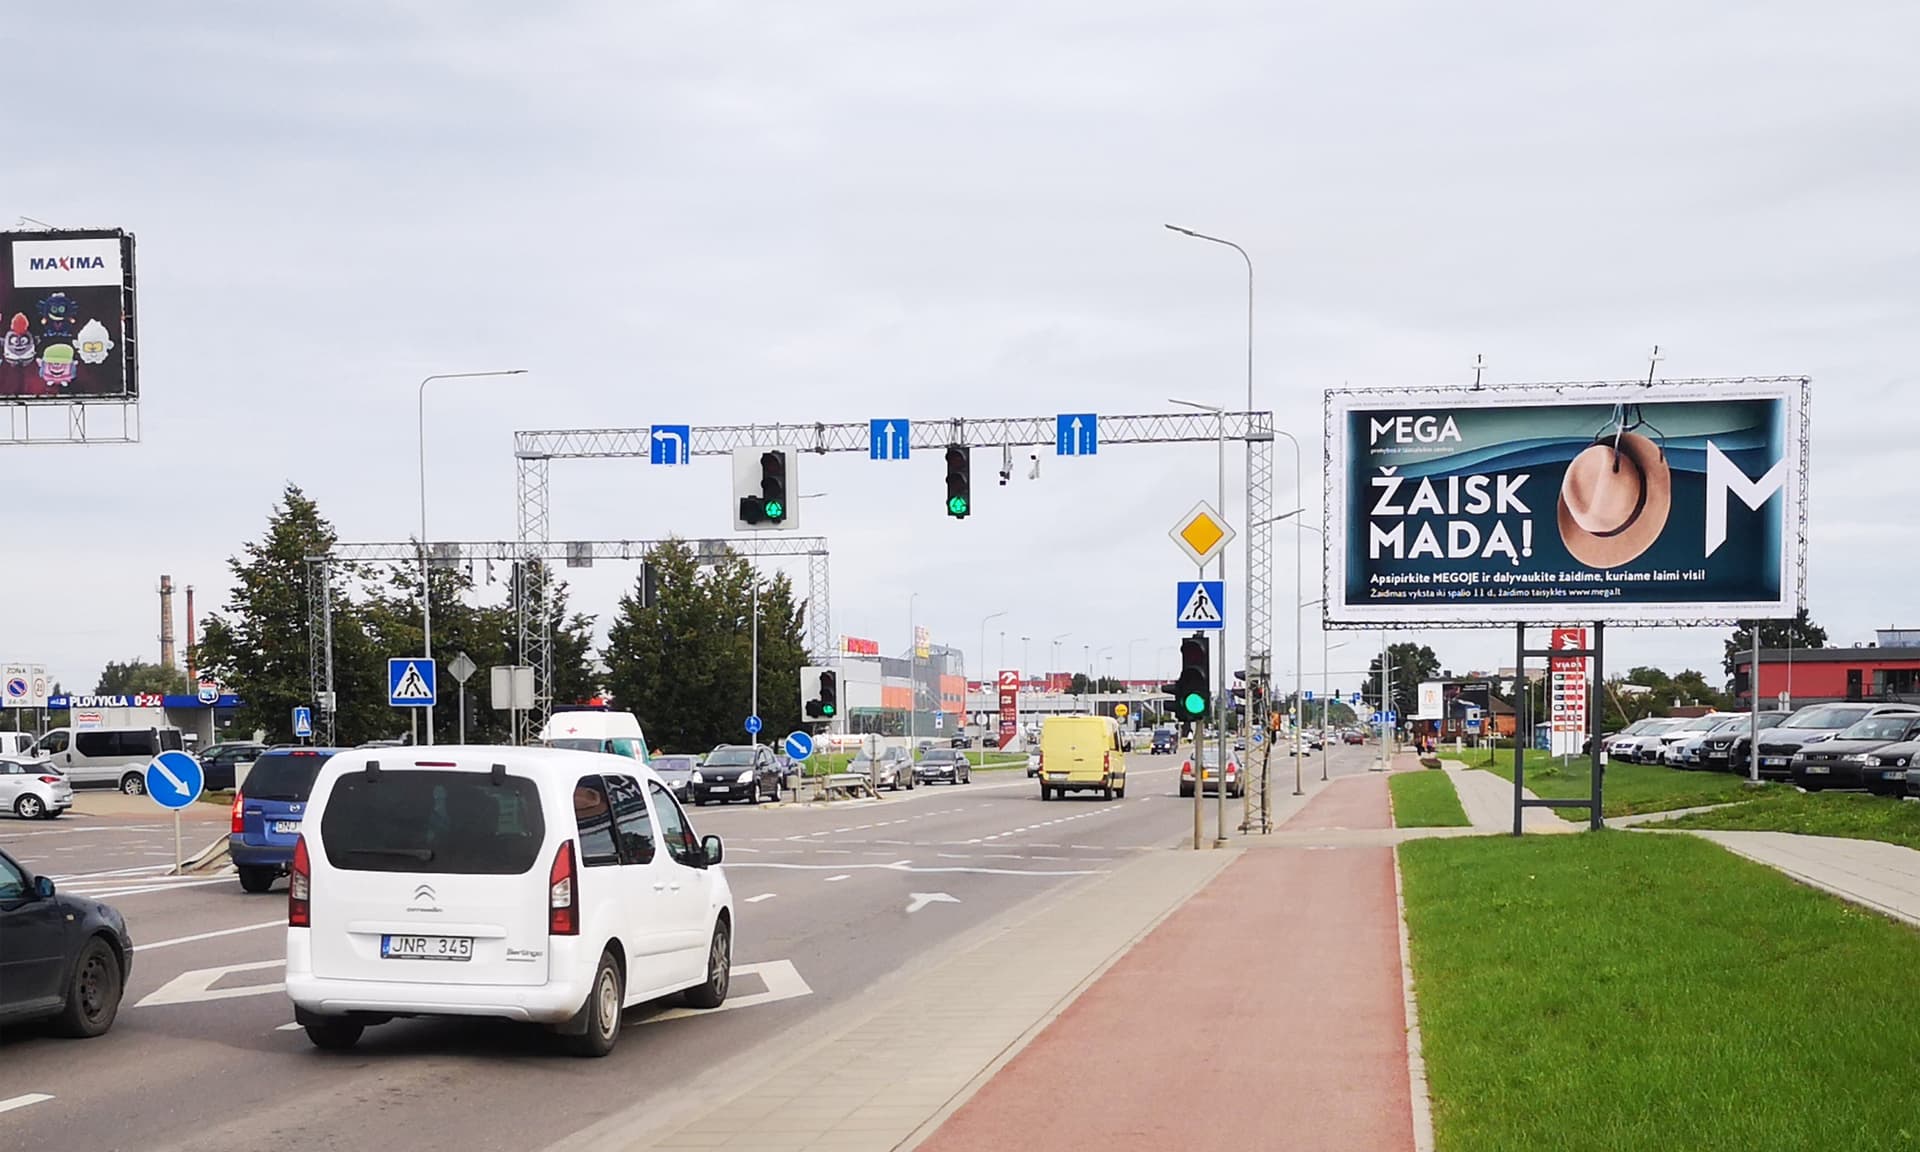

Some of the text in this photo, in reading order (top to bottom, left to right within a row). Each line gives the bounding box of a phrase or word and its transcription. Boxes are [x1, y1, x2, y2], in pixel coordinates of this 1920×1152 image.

[30, 256, 104, 271] MAXIMA
[1370, 416, 1463, 446] MEGA
[1370, 465, 1532, 516] ŽAISK
[1370, 520, 1532, 566] MADĄ!
[1370, 573, 1430, 586] Apsipirkite
[1432, 572, 1480, 585] MEGOJE
[1482, 572, 1491, 582] ir
[1493, 571, 1557, 585] dalyvaukite
[1558, 570, 1604, 582] žaidime,
[1605, 570, 1651, 581] kuriame
[1653, 569, 1680, 581] laimi
[69, 696, 129, 708] PLOVYKLA
[133, 694, 162, 708] 0-24
[392, 938, 469, 954] JNR 345
